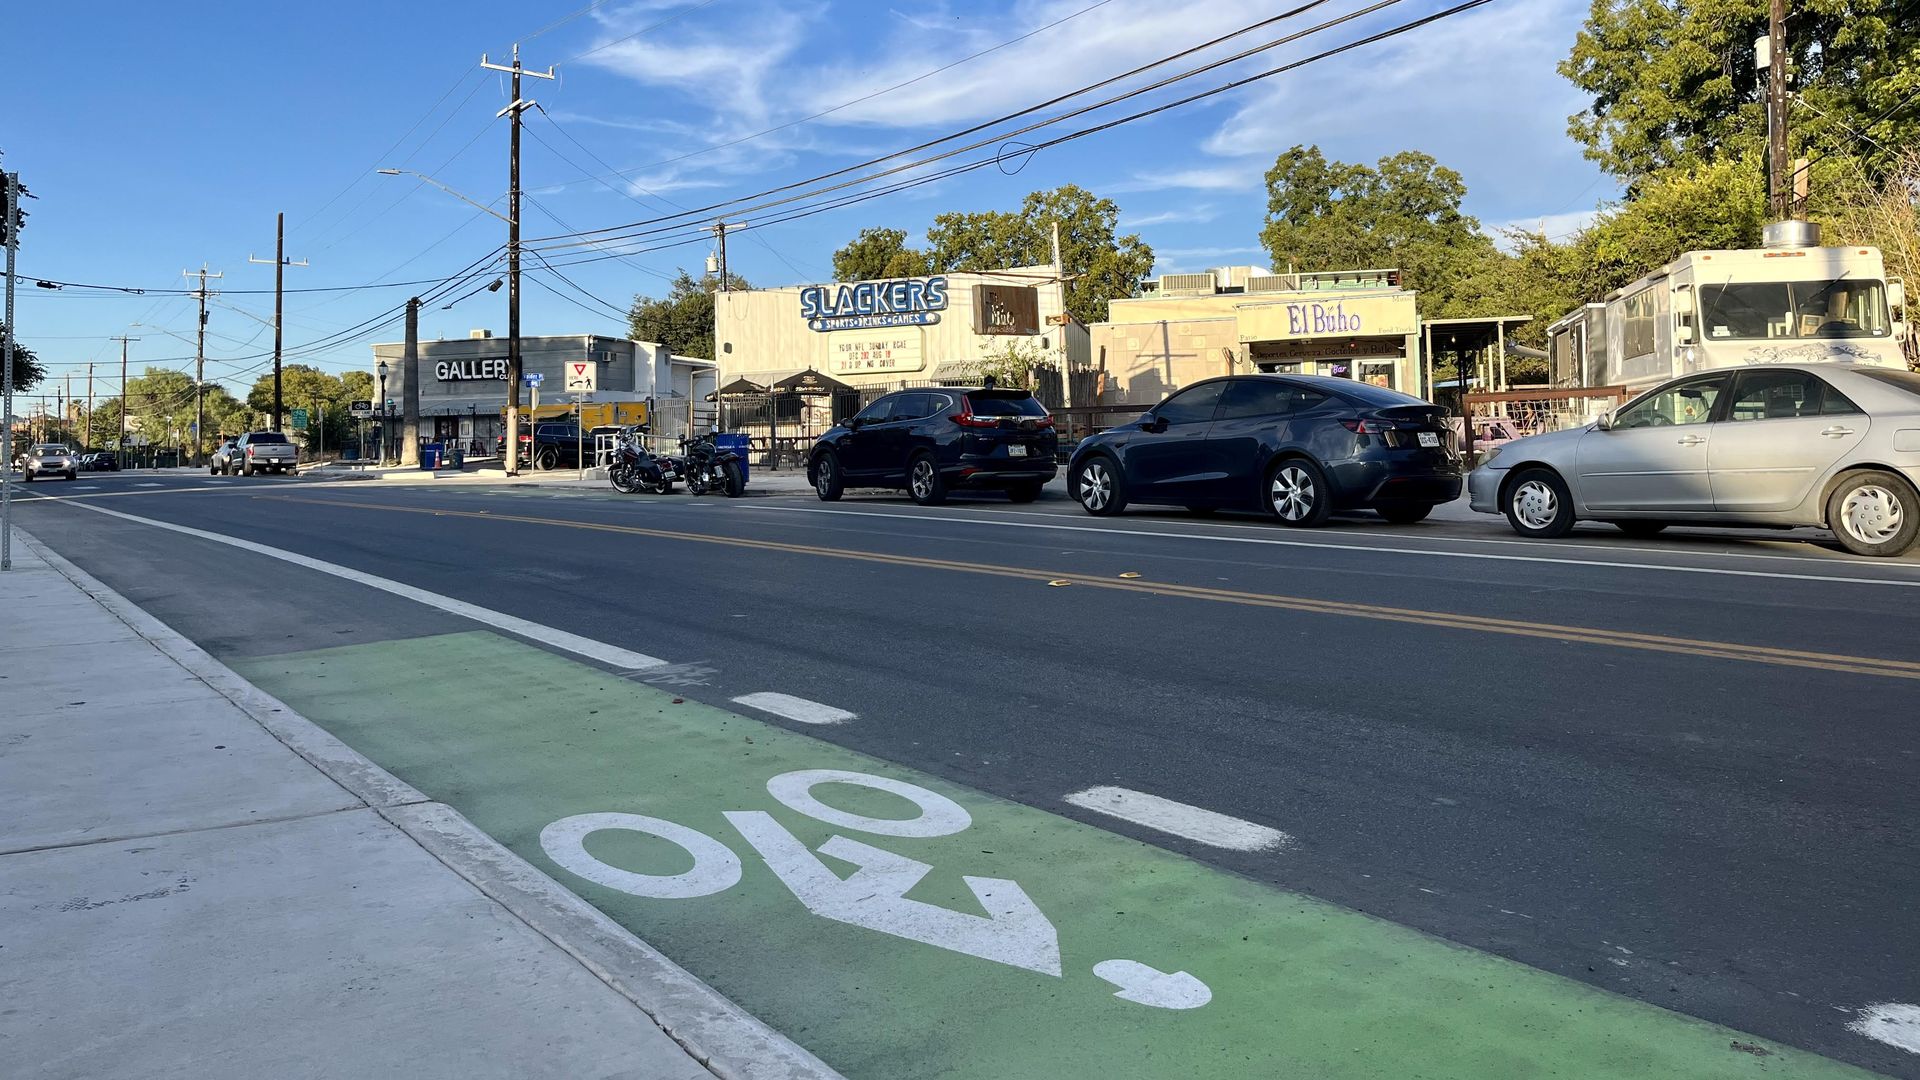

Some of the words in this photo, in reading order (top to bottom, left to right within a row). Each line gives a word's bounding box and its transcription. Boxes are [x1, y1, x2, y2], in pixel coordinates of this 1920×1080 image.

[801, 277, 948, 318] SLACKERS
[826, 318, 854, 329] SPORTS
[858, 316, 887, 327] DRINKS
[893, 314, 920, 324] GAMES
[1287, 305, 1309, 334] El
[1333, 364, 1346, 374] Bar
